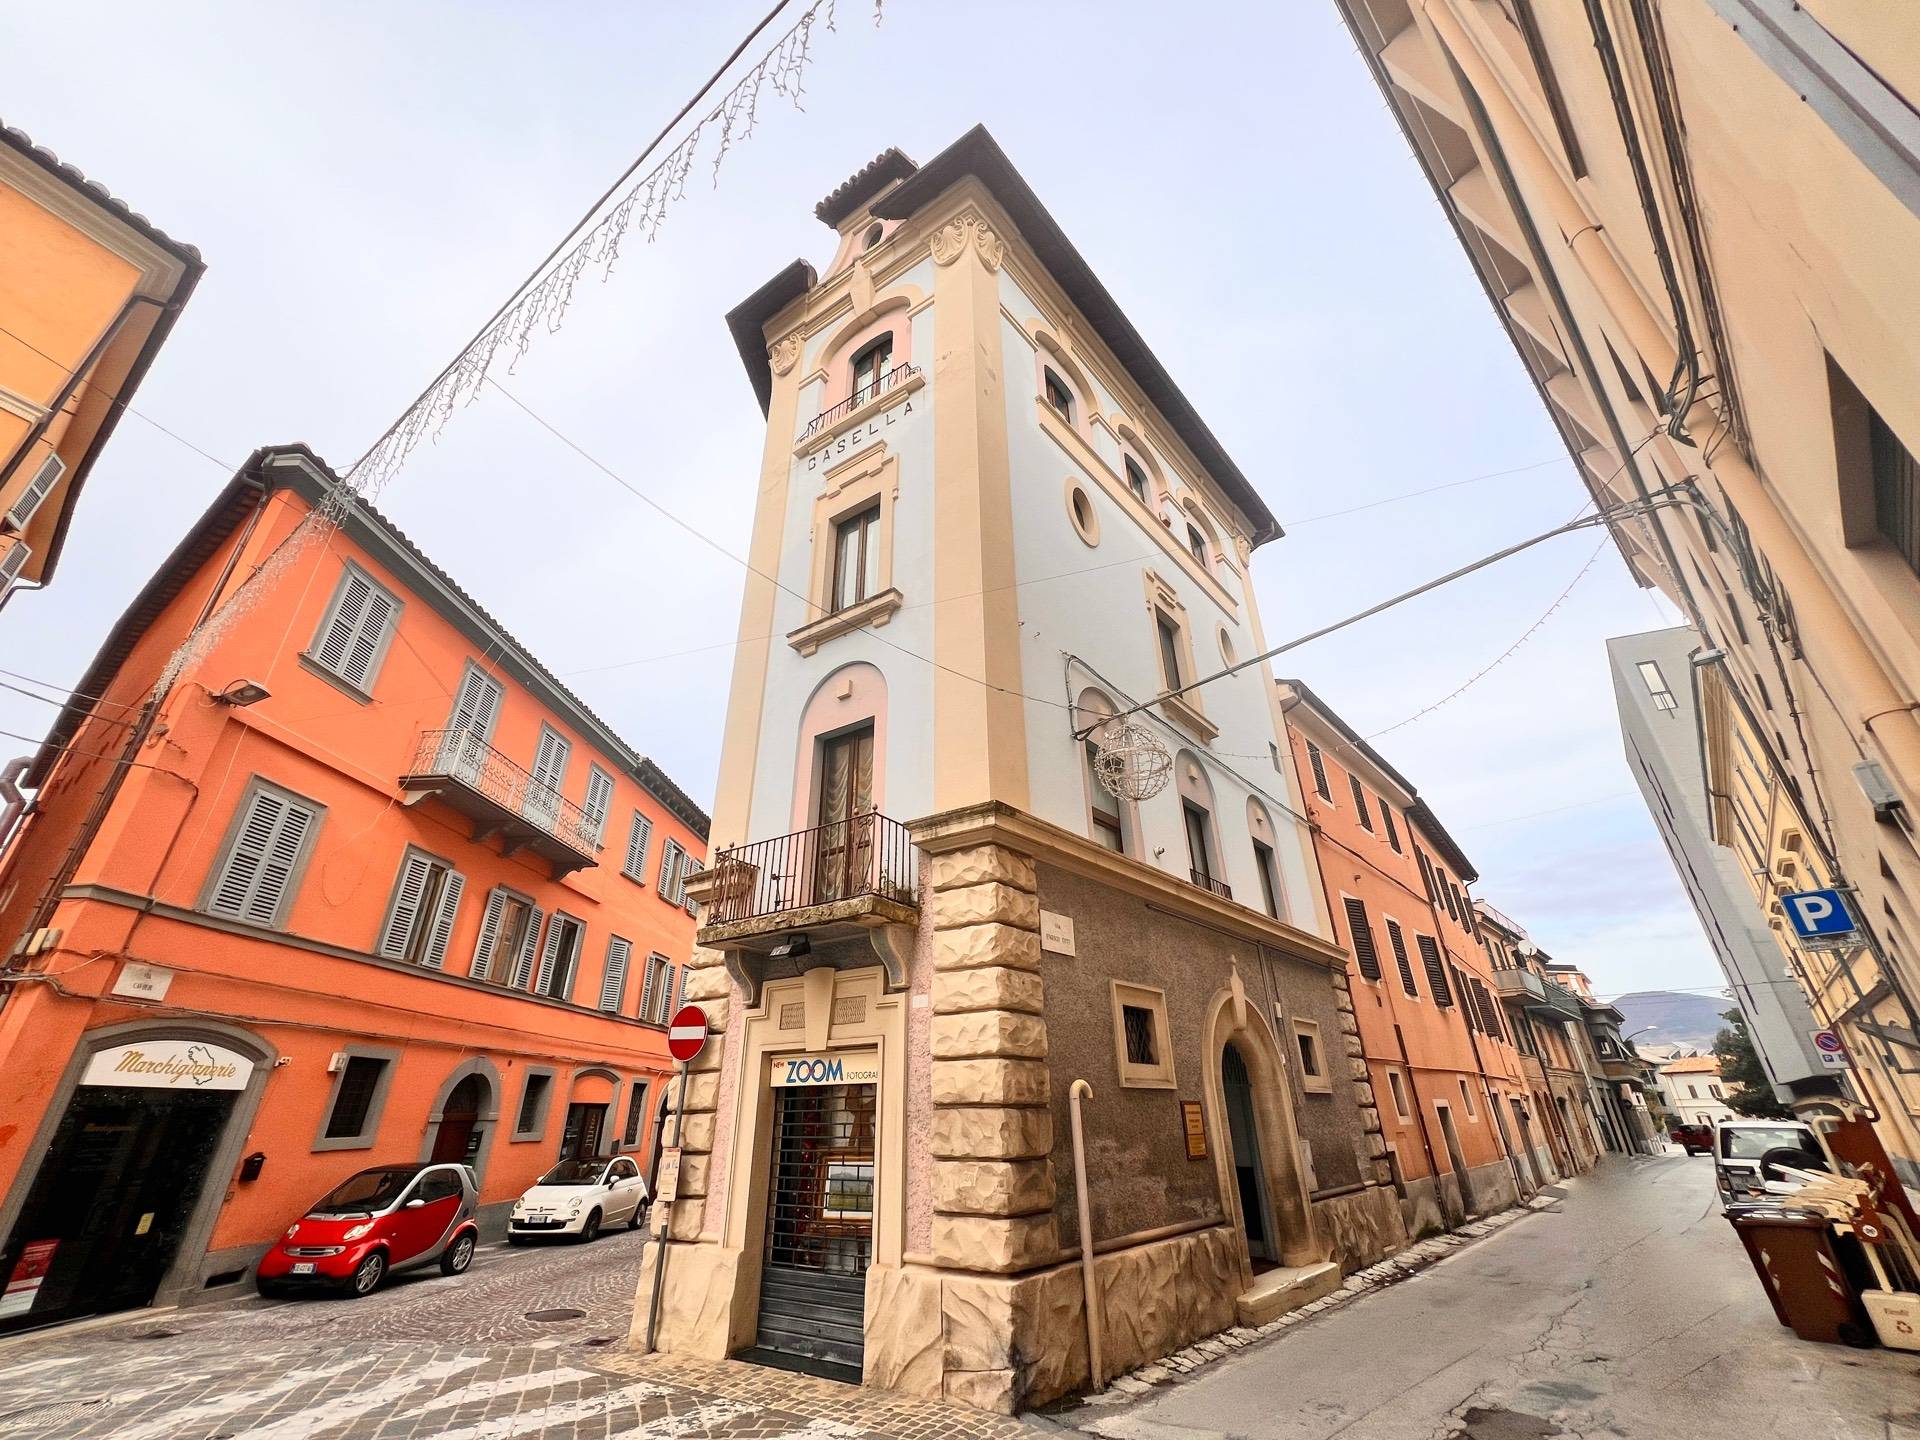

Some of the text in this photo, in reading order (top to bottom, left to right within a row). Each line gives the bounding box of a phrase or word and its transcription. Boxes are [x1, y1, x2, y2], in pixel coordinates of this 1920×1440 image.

[807, 401, 913, 471] CASELLA
[1792, 895, 1833, 932] P
[114, 1050, 237, 1084] Marchigianerie
[773, 1061, 785, 1069] NEW
[785, 1058, 844, 1083] ZOOM
